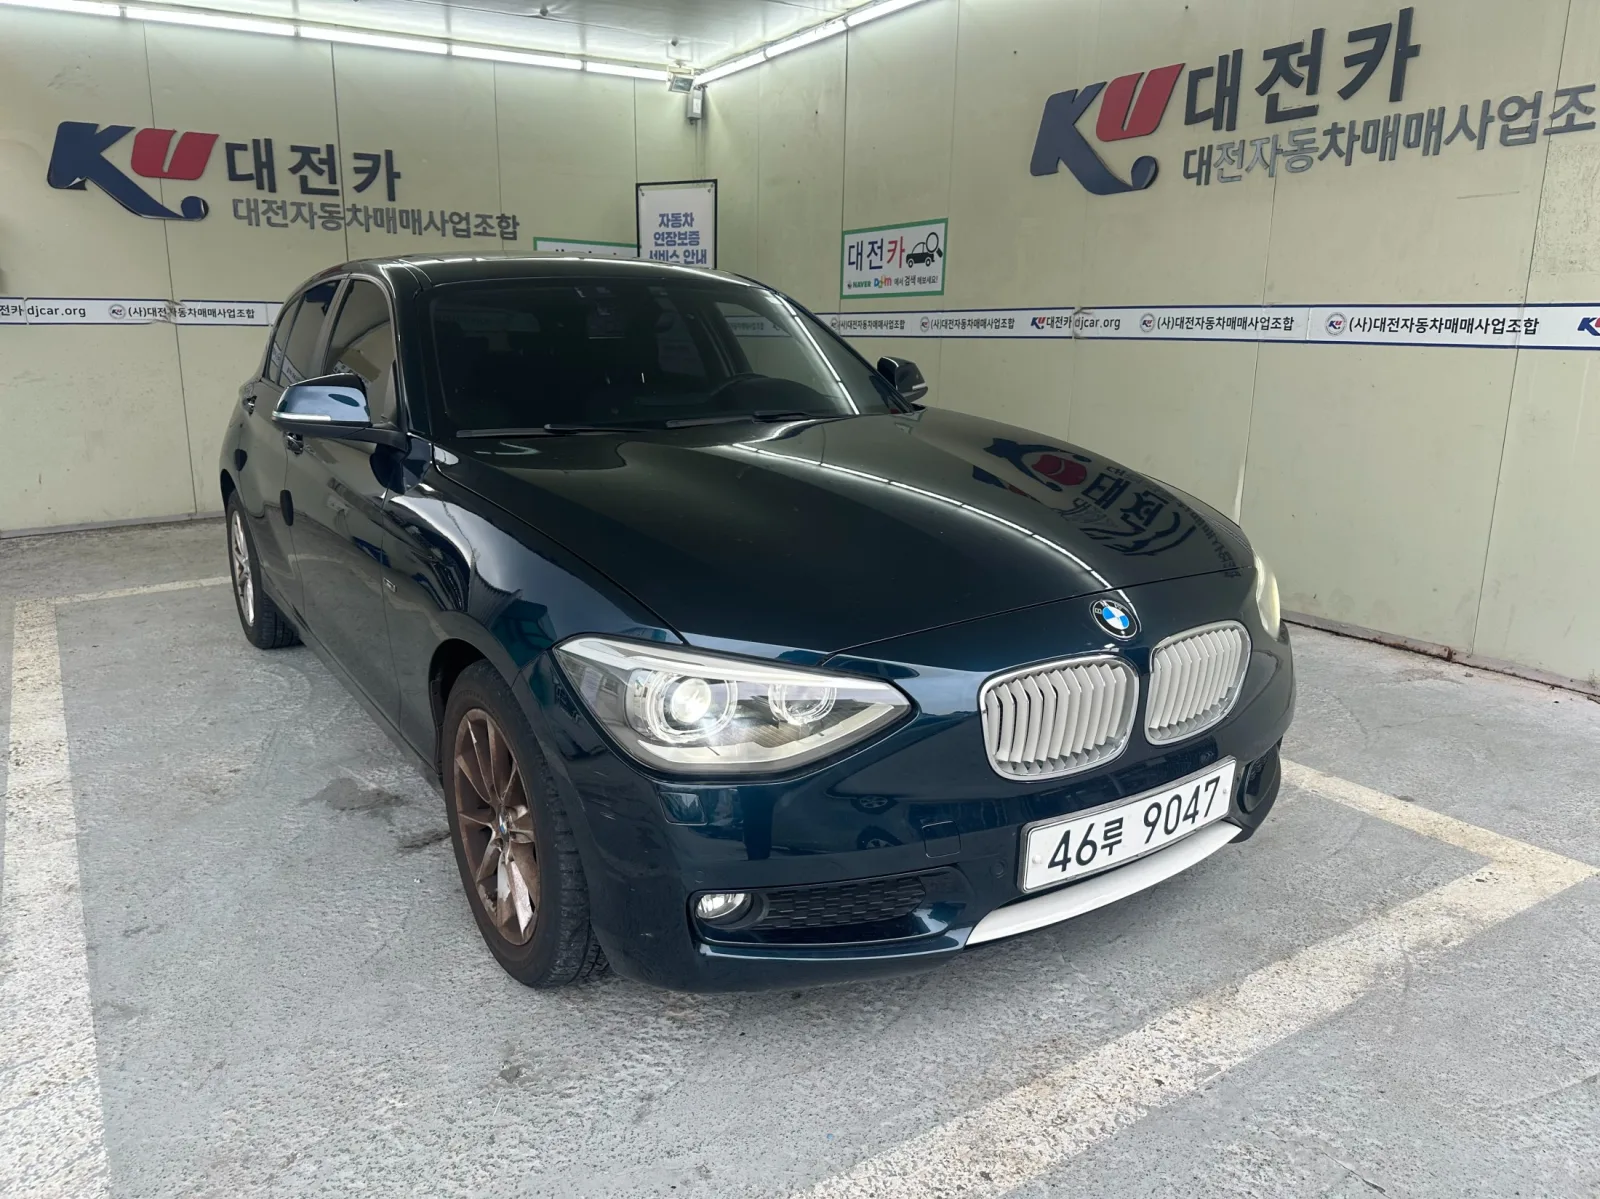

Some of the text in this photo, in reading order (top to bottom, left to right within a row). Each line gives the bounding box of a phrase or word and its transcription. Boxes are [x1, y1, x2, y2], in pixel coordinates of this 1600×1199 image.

[1183, 7, 1421, 131] 대전카
[1182, 84, 1596, 187] 대전자동차매매사업조
[225, 138, 402, 201] 대전카
[232, 198, 520, 241] 대전자동차매매사업조합
[658, 212, 695, 229] 자동차
[653, 231, 700, 247] 연장보증
[649, 249, 707, 265] 서비스 안내
[848, 236, 906, 271] 대전카
[905, 275, 916, 287] 검색
[27, 305, 86, 318] djcar.org
[839, 319, 906, 330] 사)대전자동차매매사업조합
[930, 318, 1015, 330] (사)대전자동차매매사업조합
[1046, 315, 1121, 331] 대전카 djcar.org
[1157, 315, 1295, 332] (사)대전자동차매매사업조합
[1348, 316, 1540, 336] (사)대전자동차매매사업조합
[1047, 775, 1221, 872] 46루 9047
